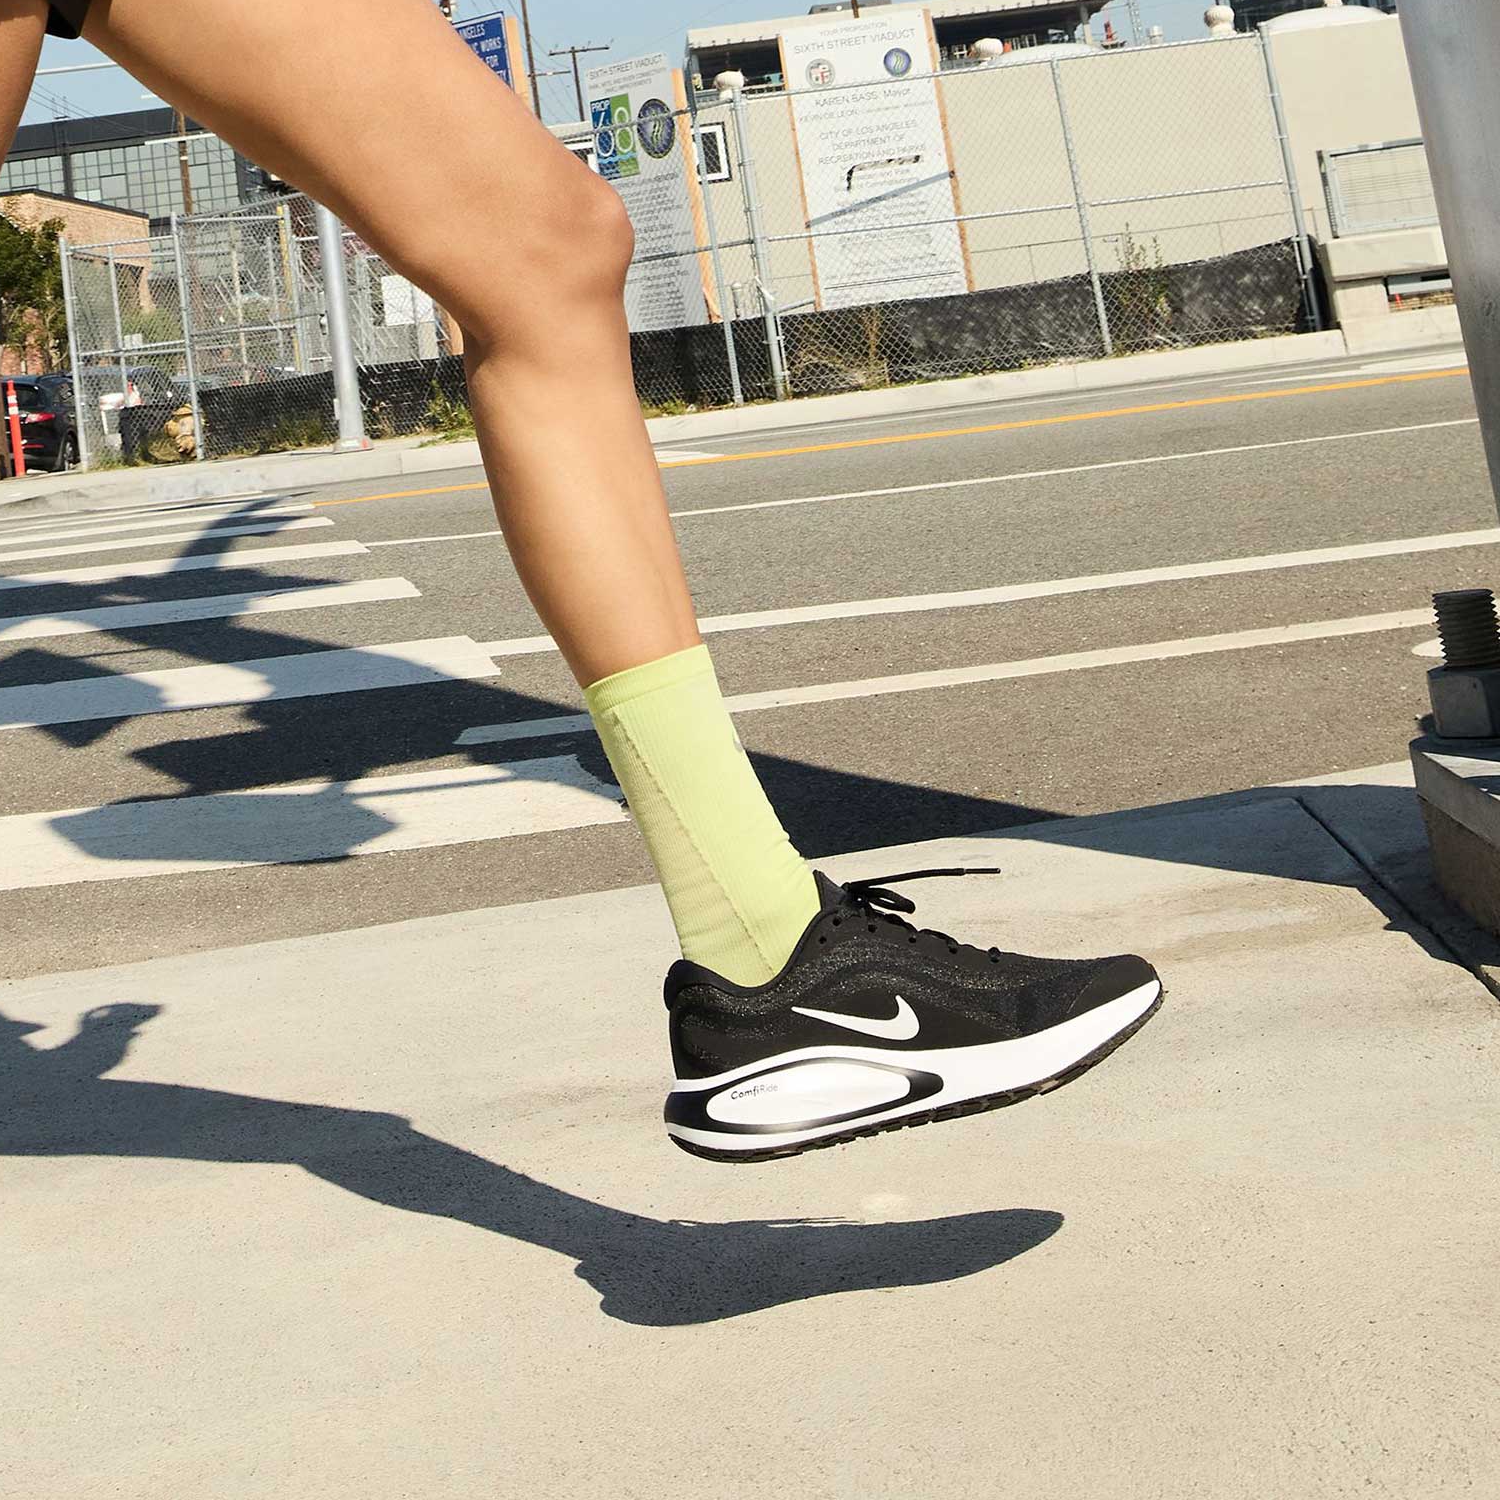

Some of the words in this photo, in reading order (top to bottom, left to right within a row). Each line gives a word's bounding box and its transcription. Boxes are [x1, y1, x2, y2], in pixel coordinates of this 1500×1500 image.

[480, 36, 501, 52] WORKS
[793, 41, 825, 55] SIXTH
[827, 35, 869, 50] STREET
[869, 28, 916, 45] VIADUCT
[608, 60, 633, 76] STREET
[633, 53, 663, 68] VIADUCT
[591, 99, 610, 112] PROP
[814, 95, 850, 107] KAREN
[819, 129, 840, 141] CITY
[855, 125, 874, 136] LOS
[875, 118, 918, 133] ANGELES
[832, 135, 891, 151] DEPARTMENT
[818, 150, 876, 165] RECREATION
[730, 1084, 779, 1100] ComfiRide
